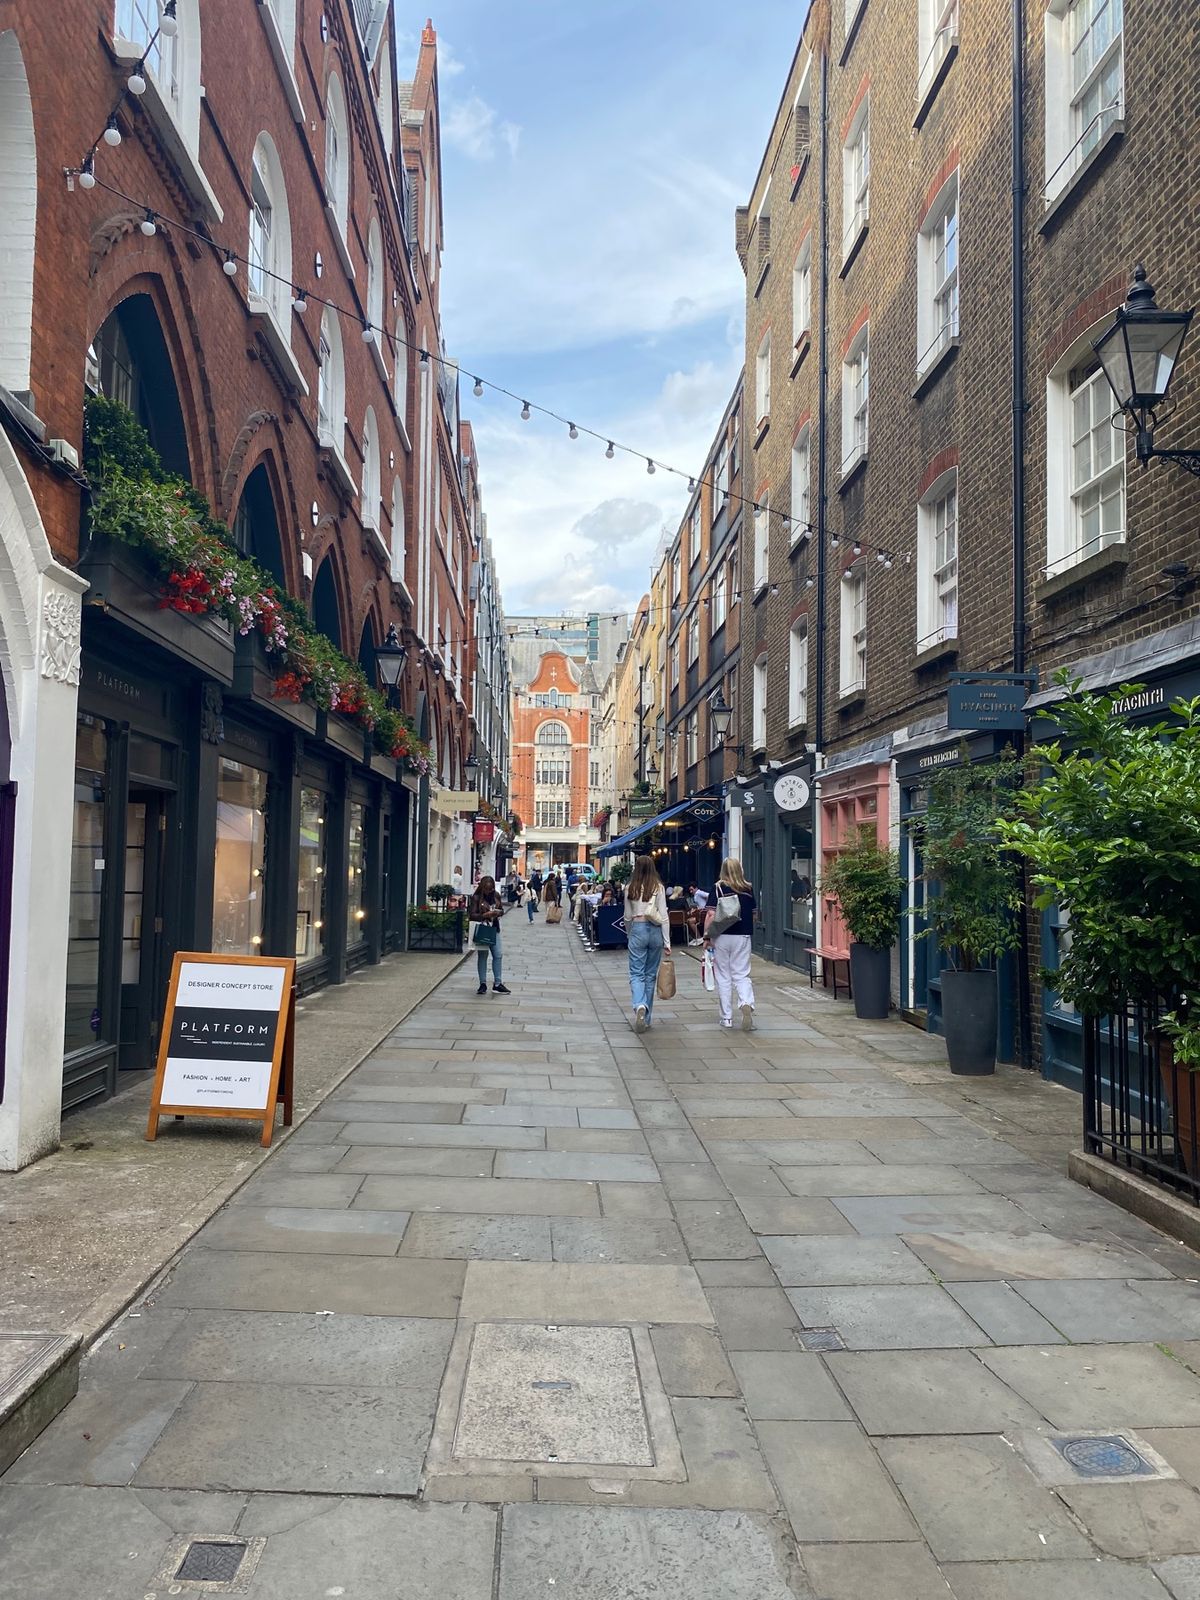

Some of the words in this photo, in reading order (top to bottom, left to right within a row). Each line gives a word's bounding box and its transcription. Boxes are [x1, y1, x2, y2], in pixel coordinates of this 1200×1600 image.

[96, 671, 143, 701] PLATFORM
[960, 702, 1018, 712] HYACINTH
[780, 779, 803, 789] ASTRID
[781, 797, 802, 806] MIYU
[181, 1022, 268, 1035] PLATFORM
